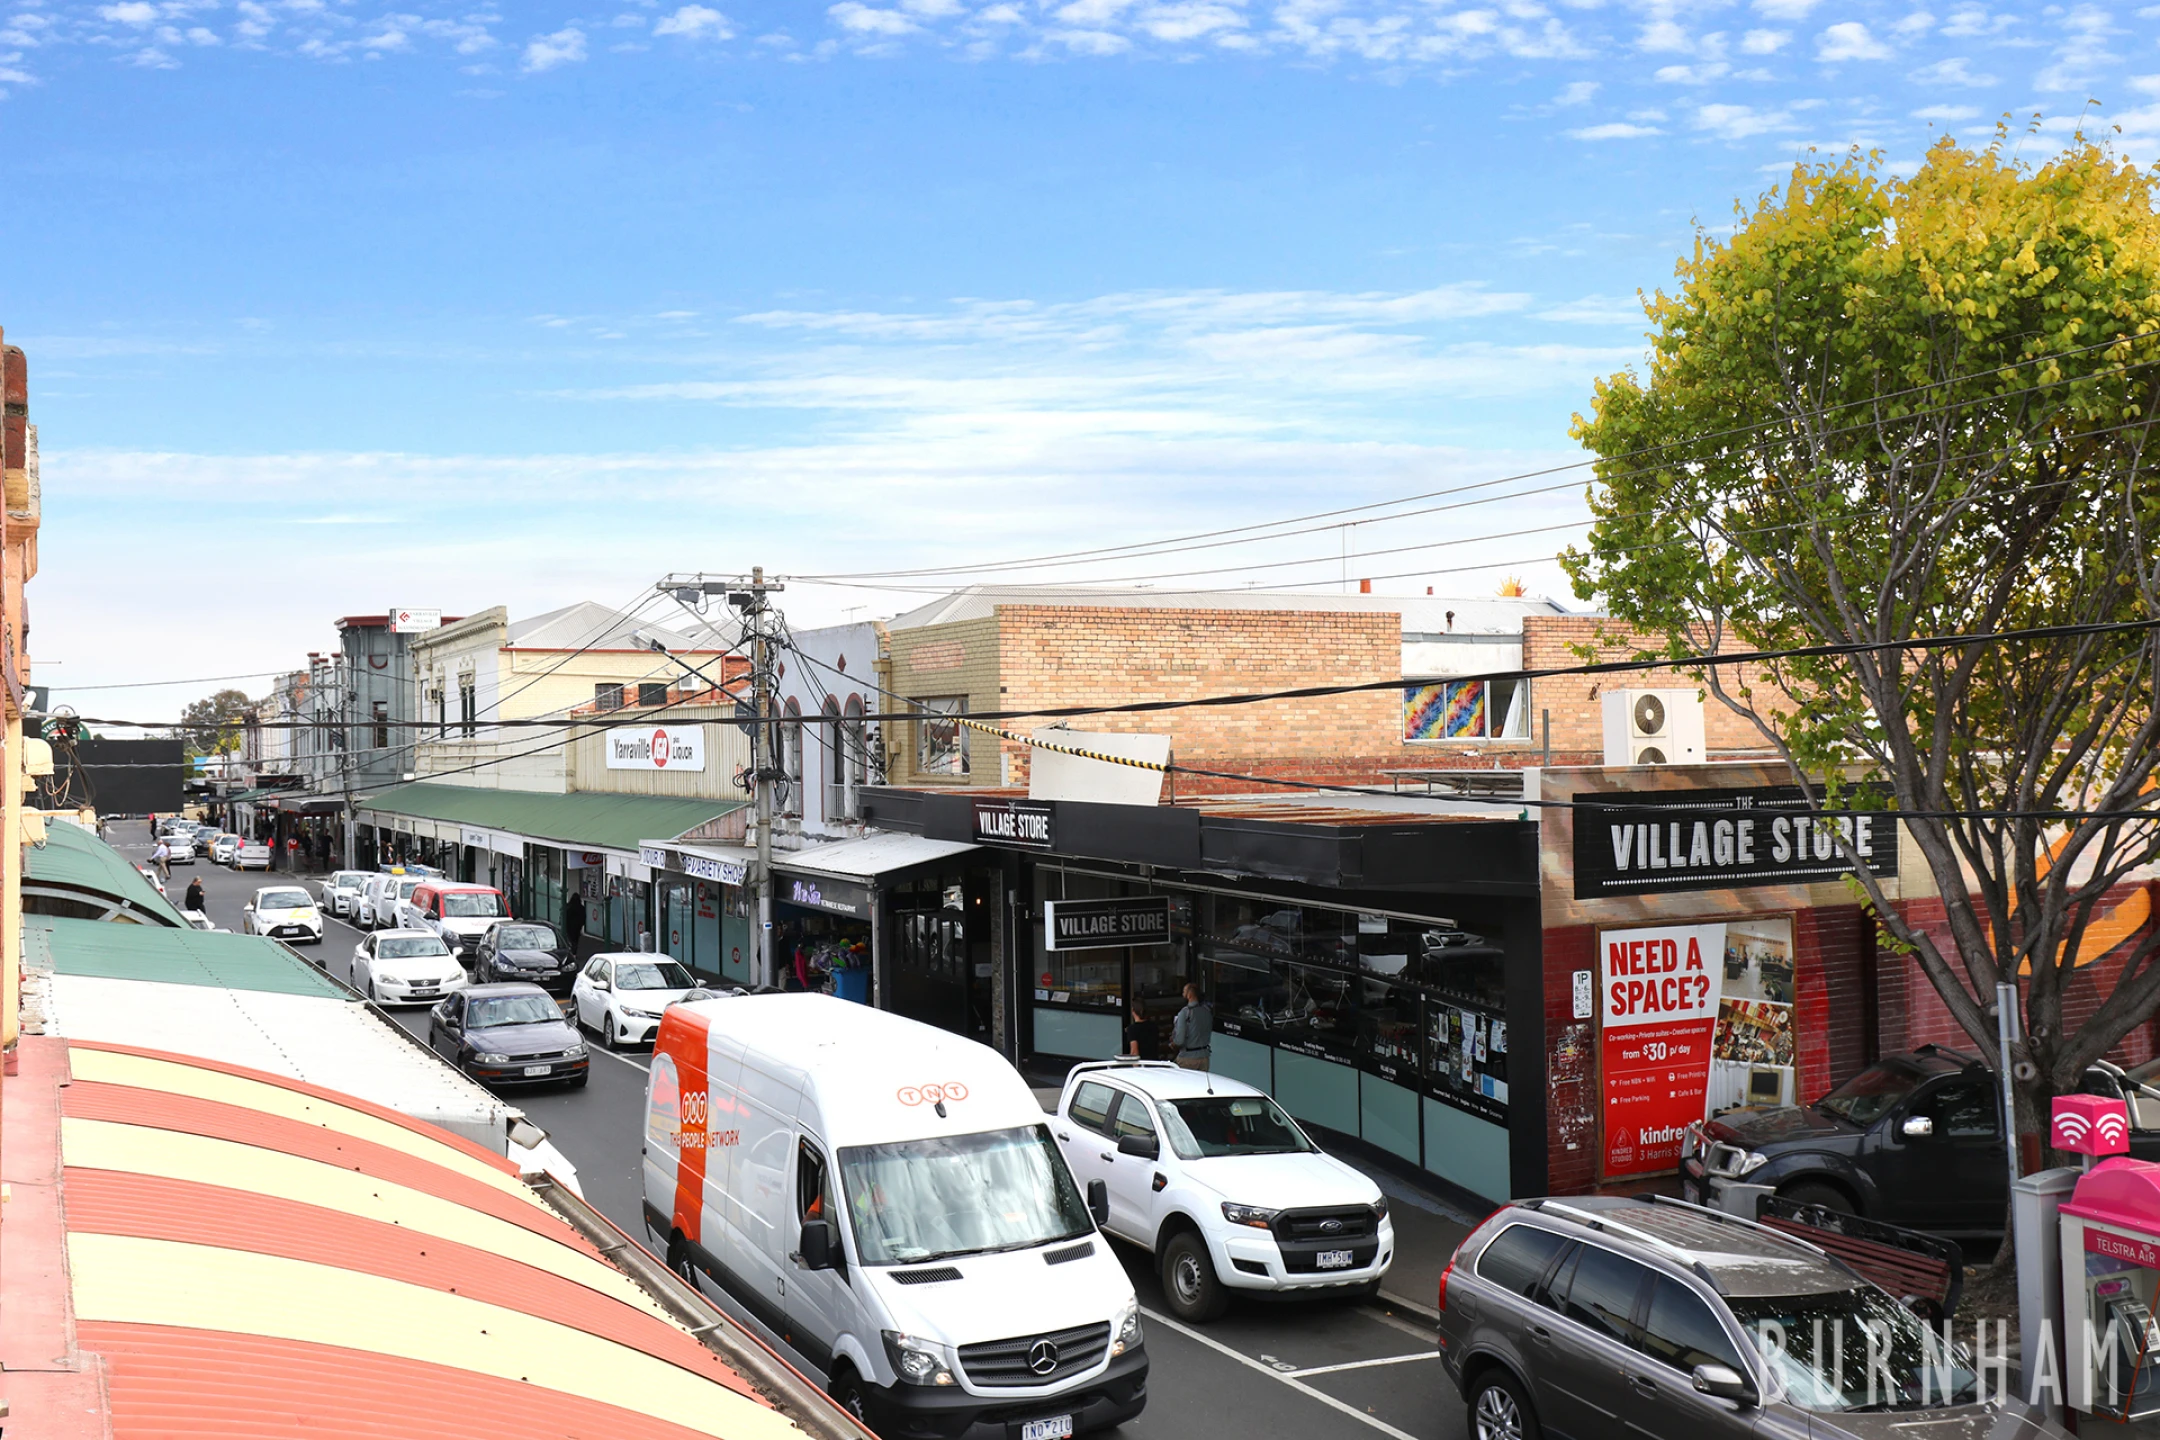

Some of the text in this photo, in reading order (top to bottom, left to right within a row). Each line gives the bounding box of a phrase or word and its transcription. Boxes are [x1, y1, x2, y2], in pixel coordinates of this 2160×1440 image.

[614, 738, 650, 760] Yarraville
[672, 746, 693, 760] LIQUOR
[1736, 796, 1754, 810] THE
[979, 812, 1049, 840] VILLAGE STORE
[1611, 816, 1873, 871] VILLAGE STORE
[1060, 912, 1164, 936] VILLAGE STORE
[1609, 936, 1704, 977] NEED A
[1577, 972, 1588, 984] 1P
[1610, 974, 1710, 1016] SPACE?
[1622, 1050, 1640, 1059] from
[1642, 1042, 1667, 1061] $30
[1678, 1044, 1691, 1055] day
[670, 1129, 740, 1148] THE PEOPLE NETWORK
[1611, 1147, 1633, 1155] KINDRED
[1611, 1155, 1632, 1163] STUDIOS
[1640, 1146, 1682, 1161] 3 Harris S
[2096, 1237, 2136, 1259] TELSTRA
